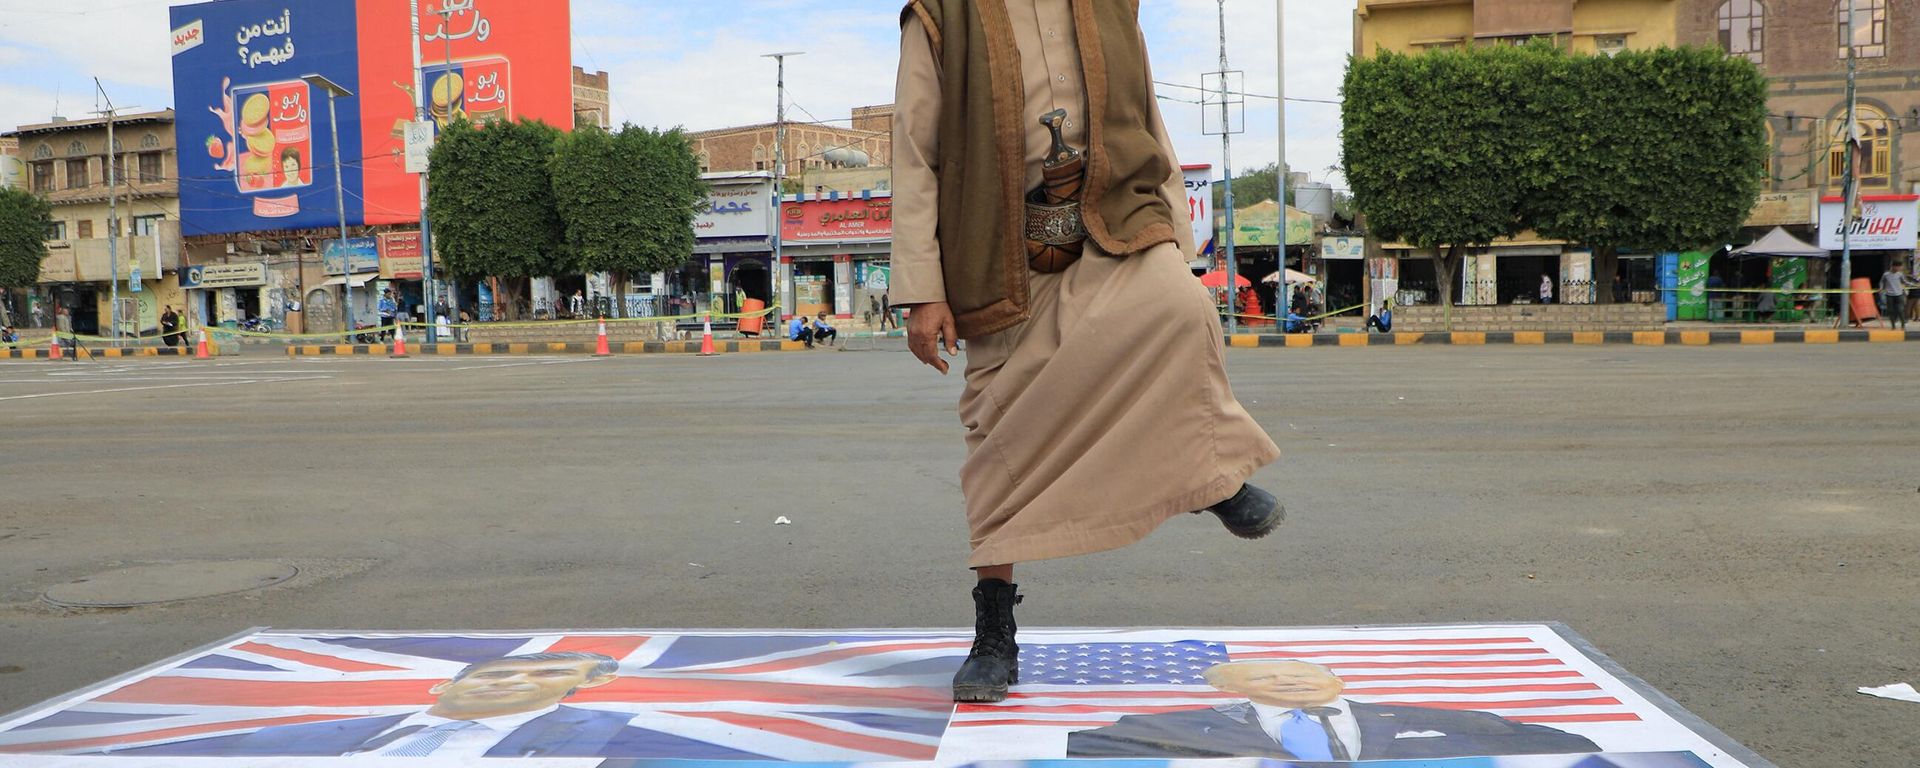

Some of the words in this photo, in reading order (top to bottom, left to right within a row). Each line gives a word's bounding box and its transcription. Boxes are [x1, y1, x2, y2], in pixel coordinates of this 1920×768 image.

[262, 8, 290, 36] أنت
[424, 10, 490, 41] ولد
[174, 27, 200, 46] جديد
[237, 24, 261, 45] من
[477, 71, 498, 90] ابو
[281, 92, 300, 110] ابو
[467, 85, 505, 103] ولد
[273, 105, 307, 123] ولد
[819, 208, 870, 227] العامري
